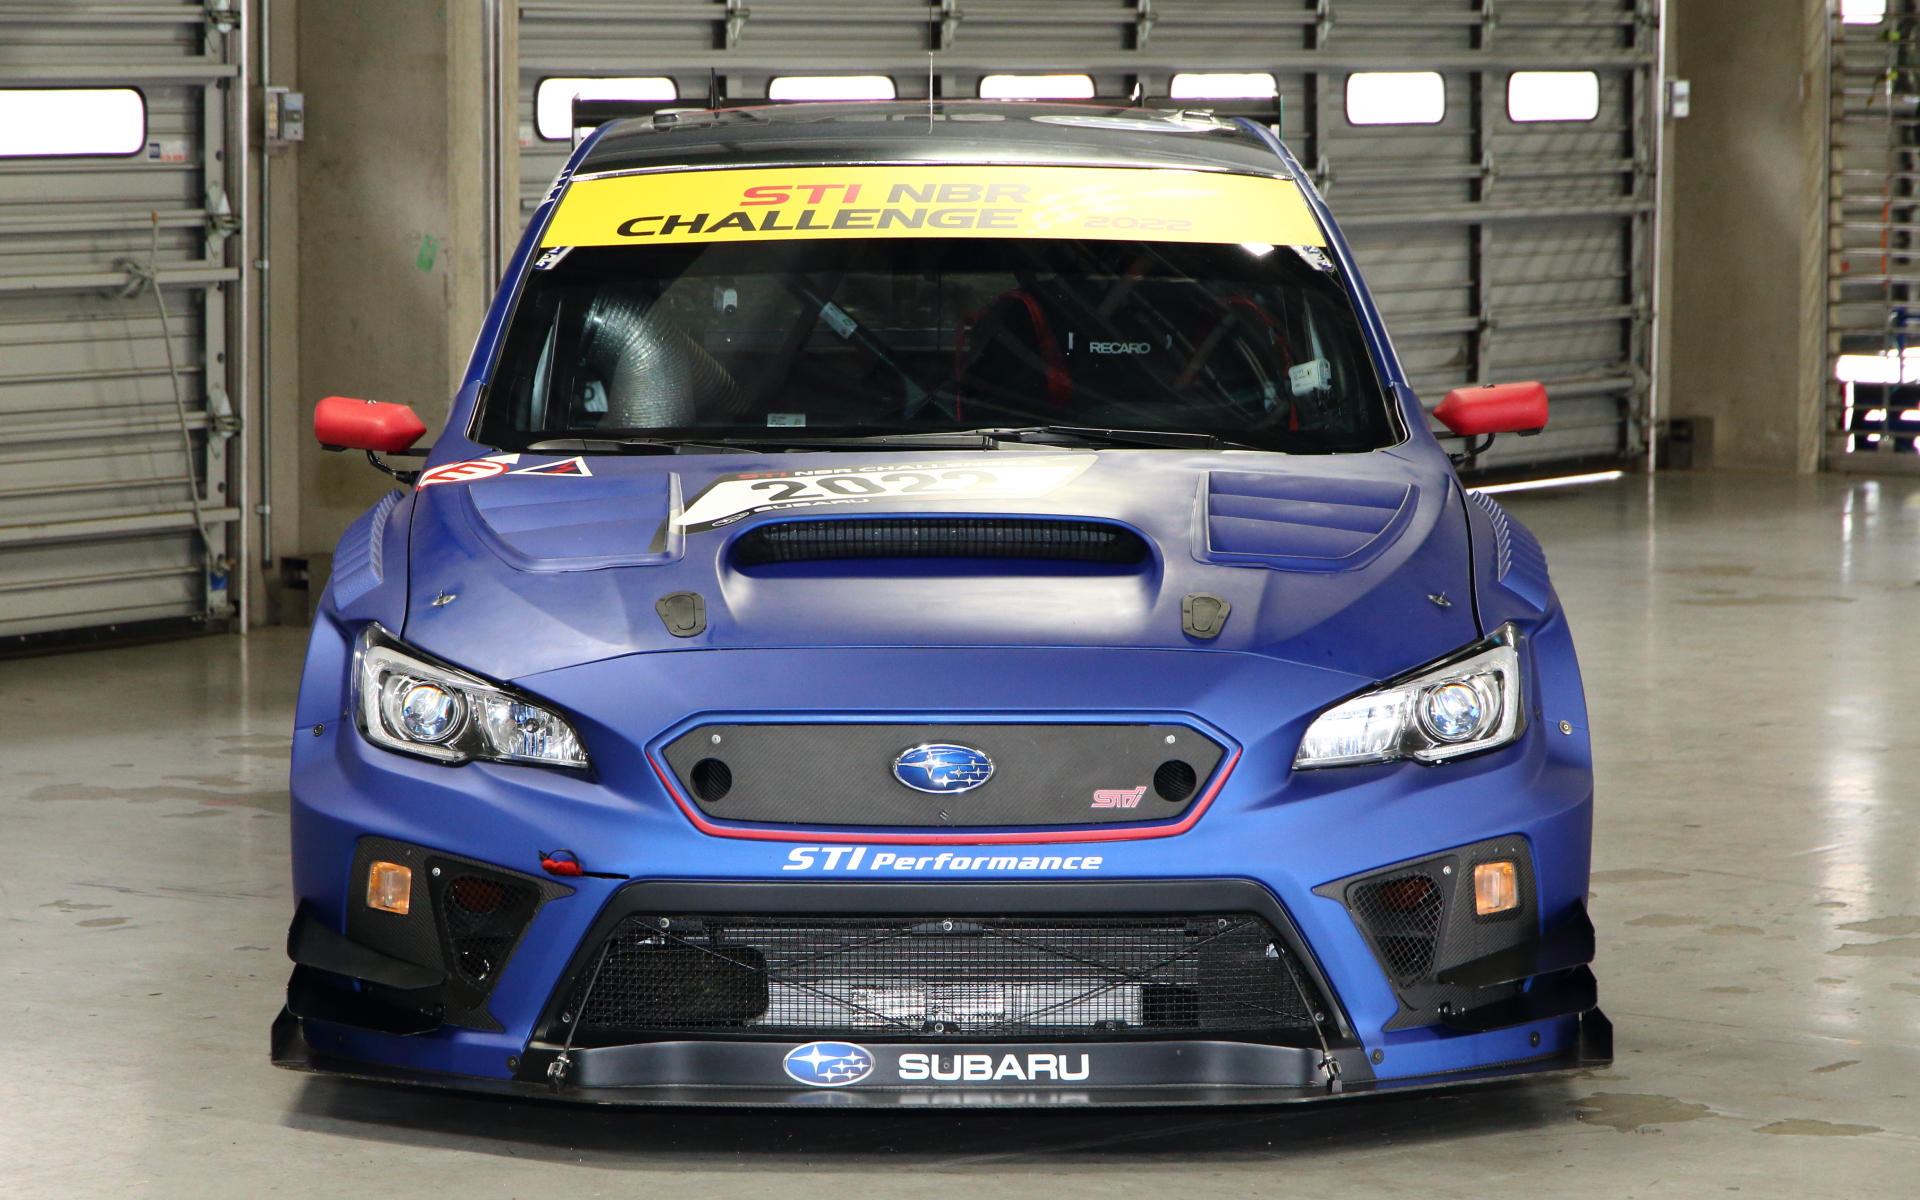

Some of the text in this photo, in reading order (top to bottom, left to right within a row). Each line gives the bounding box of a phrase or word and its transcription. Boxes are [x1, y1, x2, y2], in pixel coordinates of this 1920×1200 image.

[739, 183, 1030, 206] STI NBR
[616, 208, 1024, 237] CHALLENGE
[1084, 216, 1193, 231] 2022
[1089, 342, 1151, 354] RECARO
[750, 471, 1002, 501] 2022
[753, 498, 870, 512] SUBARU
[782, 847, 1103, 871] STI Performance
[898, 1053, 1090, 1081] SUBARU
